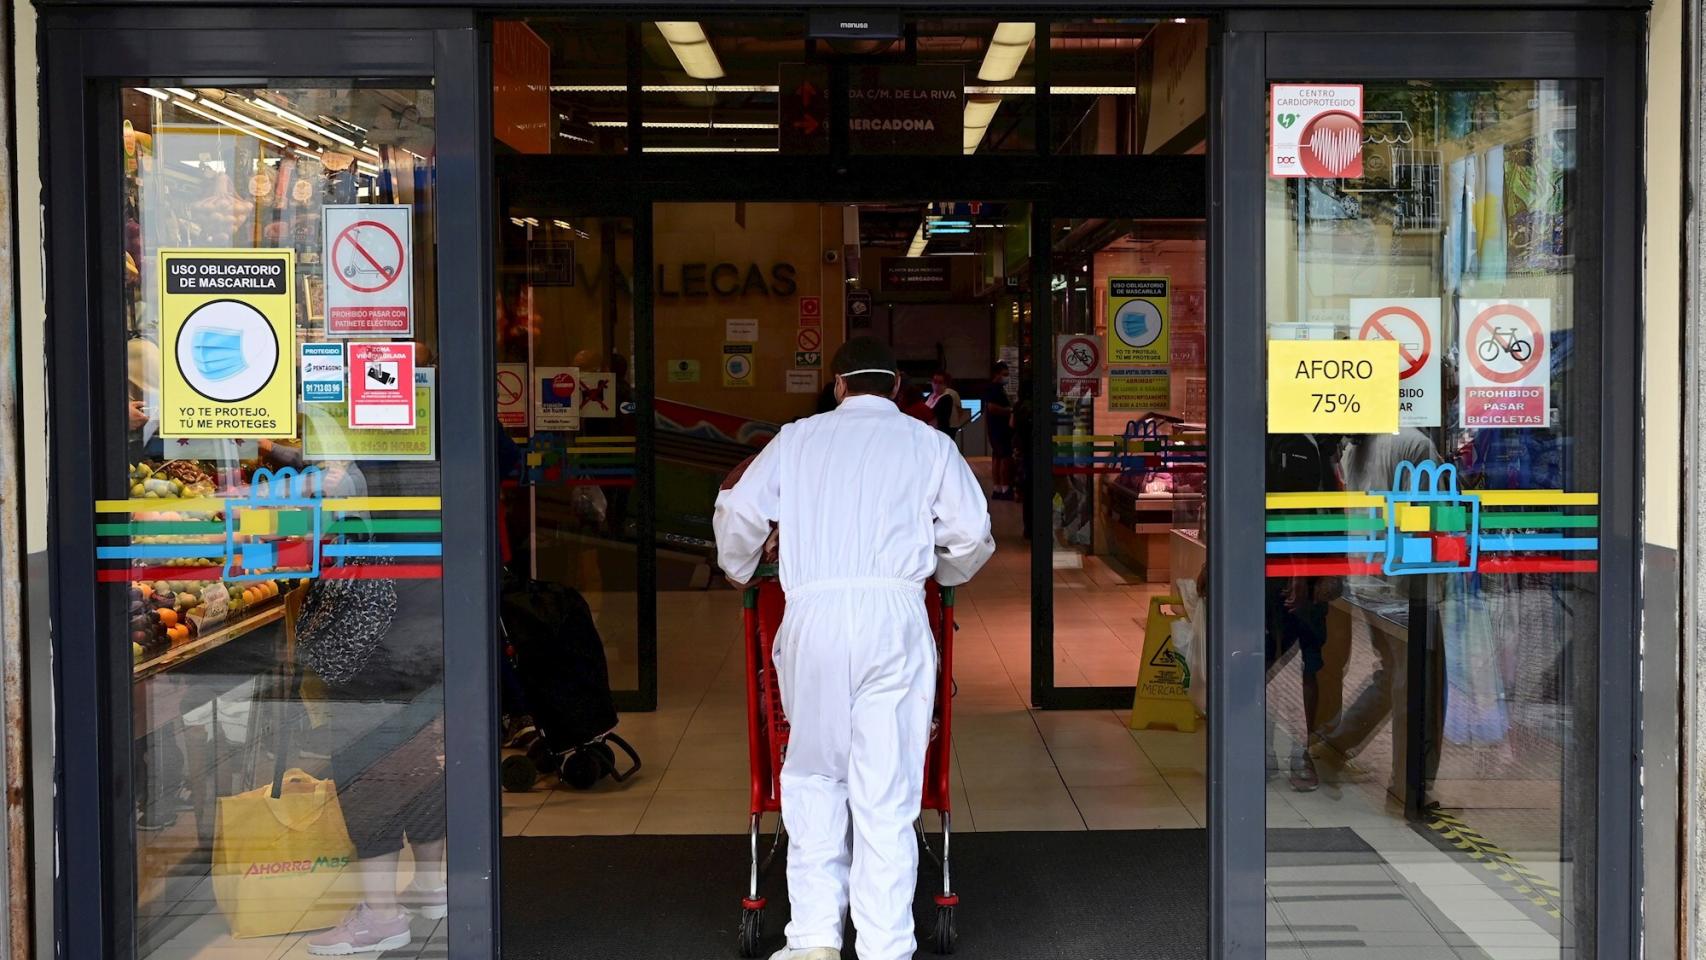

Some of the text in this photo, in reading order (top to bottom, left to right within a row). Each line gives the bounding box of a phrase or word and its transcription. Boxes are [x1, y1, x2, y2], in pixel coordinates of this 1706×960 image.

[823, 89, 863, 100] SDA
[895, 89, 910, 99] DE
[912, 89, 928, 99] LA
[930, 89, 957, 99] RIVA
[1299, 89, 1335, 97] CENTRO
[1277, 98, 1355, 107] CARDIOPROTEGIDO
[1277, 156, 1295, 164] DOC
[171, 265, 281, 275] USO OBLIGATORIO
[179, 278, 276, 288] DE MASCARILLA
[575, 263, 797, 297] VALECAS
[331, 310, 368, 318] PROHIBIDO
[391, 310, 406, 318] CON
[335, 318, 403, 327] PATINETE ELÉCTRICO
[1295, 360, 1373, 379] AFORO
[1399, 388, 1424, 398] BIDO
[1469, 390, 1540, 398] PROHIBIDO
[1311, 393, 1361, 413] 75%
[1400, 402, 1413, 412] AR
[1484, 402, 1525, 411] PASAR
[179, 407, 270, 418] YO TE PROTEJO,
[179, 417, 277, 429] TÚ ME PROTEGES
[1467, 415, 1540, 424] BICICLETAS
